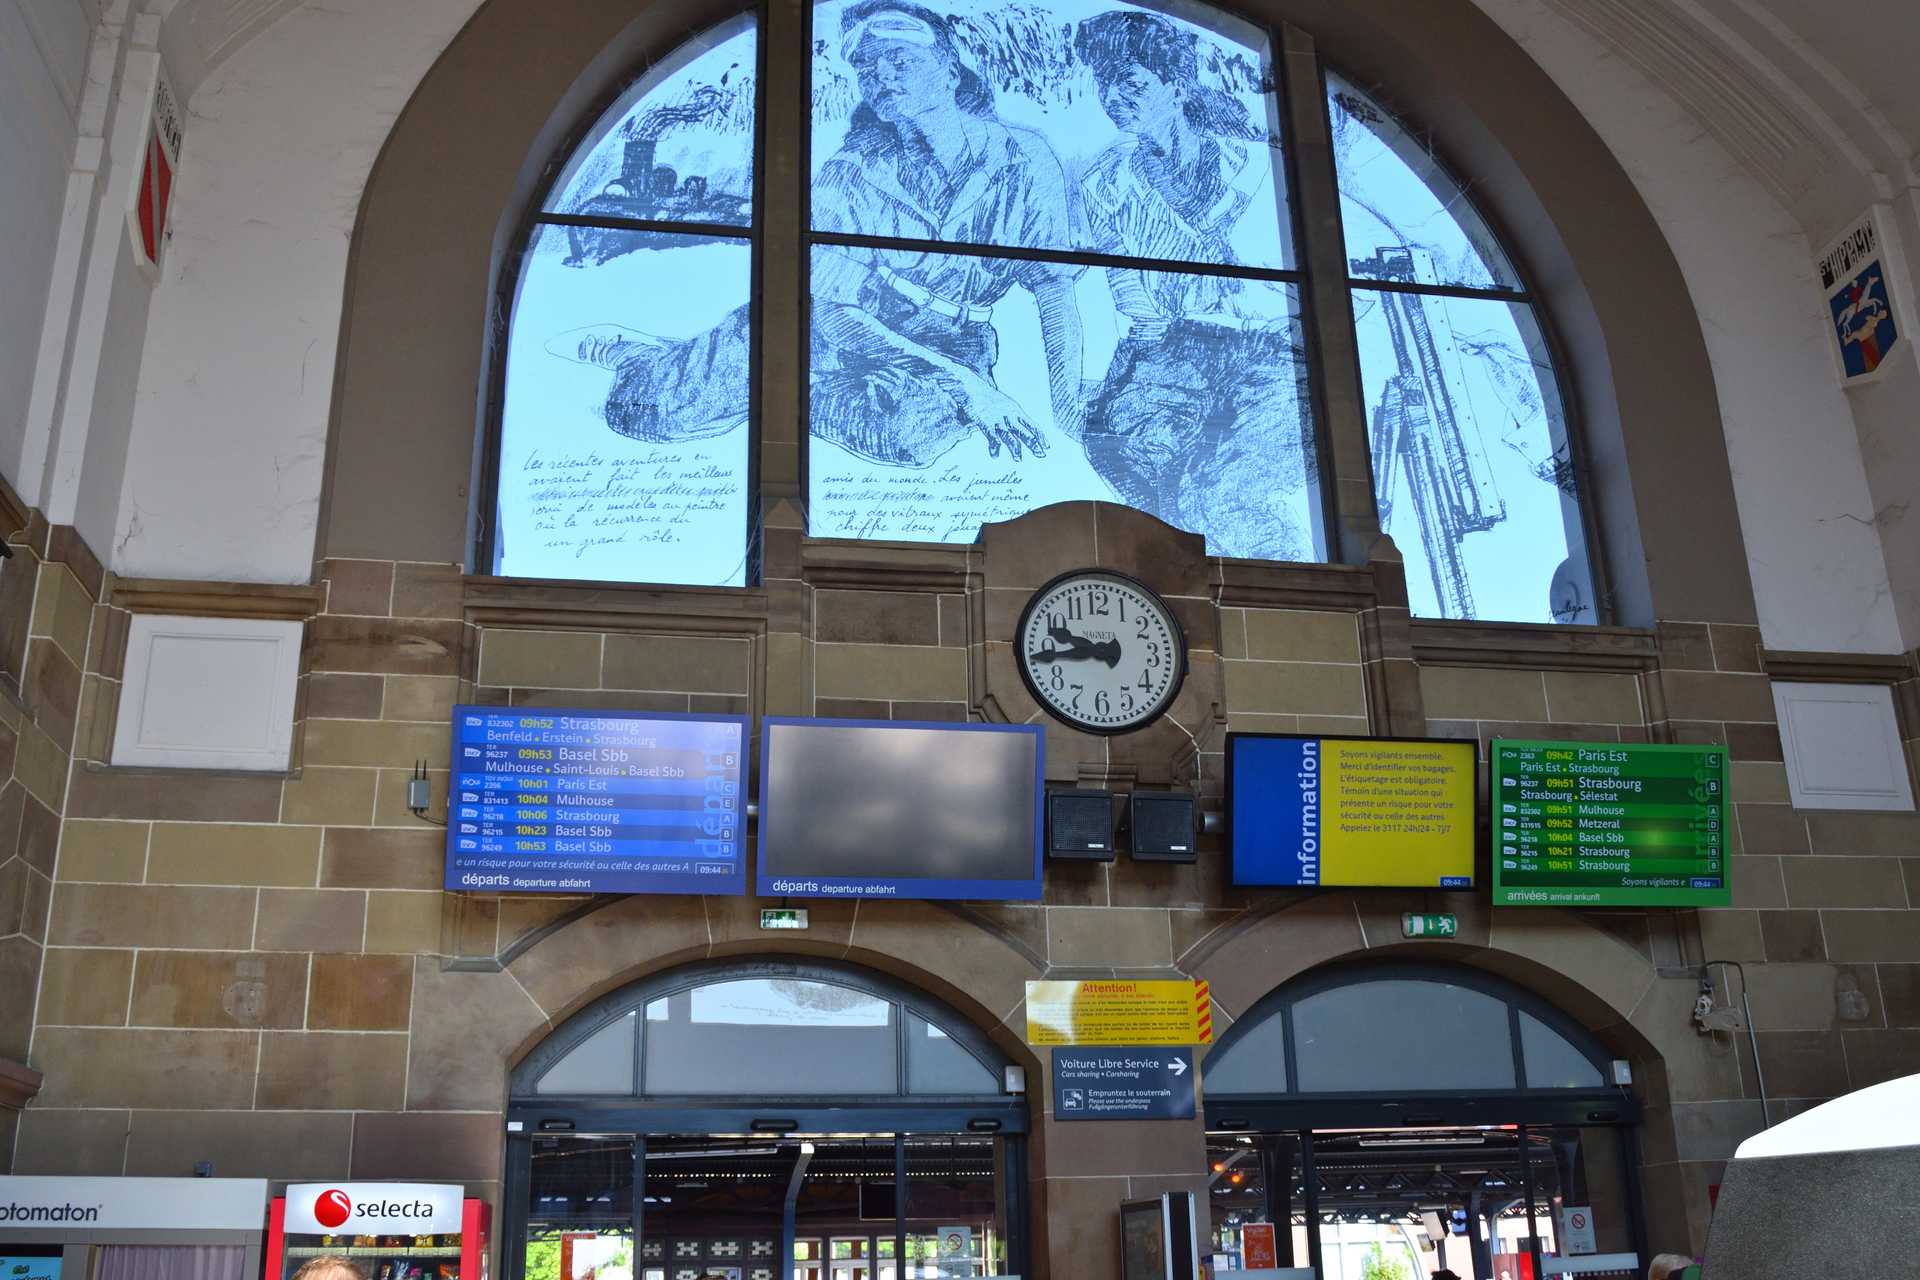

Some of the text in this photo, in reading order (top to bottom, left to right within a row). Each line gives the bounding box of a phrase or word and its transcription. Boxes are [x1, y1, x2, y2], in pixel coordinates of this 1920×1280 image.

[606, 467, 641, 490] fait
[823, 472, 854, 484] amis
[939, 465, 961, 482] Les
[963, 471, 1023, 493] jumelles
[576, 500, 594, 513] de
[564, 513, 577, 527] la
[669, 511, 692, 524] du
[835, 515, 936, 540] chiffre deux
[1067, 591, 1127, 623] 11 12 1
[1136, 616, 1150, 640] 2
[1147, 642, 1160, 668] 3
[1051, 665, 1154, 694] 8 4
[1070, 684, 1134, 716] 7 6 5
[519, 717, 640, 735] 09h52 Strasbourg
[487, 730, 656, 749] Benfeld Erstein Strasbourg
[518, 749, 553, 760] 09h53
[559, 747, 596, 761] Basel
[601, 748, 629, 762] Sbb
[726, 755, 734, 765] B
[1578, 749, 1606, 761] Paris
[1609, 750, 1627, 762] Est
[1709, 755, 1716, 764] C
[486, 761, 684, 778] Mulhouse Saint-Louis Basel Sbb
[1520, 762, 1619, 776] Paris Est Strasbourg
[518, 779, 607, 791] 10h01 Paris Est
[1546, 777, 1717, 792] 09h51 Strasbourg B
[517, 794, 615, 806] 10h04 Mulhouse
[1520, 789, 1618, 802] Strasbourg Sélestat
[516, 809, 620, 825] 10h06 Strasbourg
[1297, 741, 1317, 886] information
[1547, 805, 1573, 814] 09h51
[1579, 805, 1625, 815] Mulhouse
[515, 825, 547, 836] 10h23
[555, 824, 586, 837] Basel
[589, 825, 612, 838] Sbb
[1546, 818, 1573, 829] 09h52
[1579, 818, 1621, 829] Metzeral
[1547, 832, 1624, 843] 10h04 Basel Sbb
[515, 840, 612, 853] 10h53 Basel Sbb
[1547, 846, 1573, 856] 10h21
[1579, 846, 1631, 859] Strasbourg
[478, 857, 506, 869] risque
[508, 859, 531, 869] pour
[533, 860, 557, 869] votre
[559, 859, 594, 870] sécurité
[611, 861, 632, 870] celle
[634, 861, 650, 870] des
[652, 862, 680, 871] autres
[1548, 860, 1630, 872] 10h51 Strasbourg
[462, 873, 591, 888] départs departure abfahrt
[773, 879, 896, 895] départs departure abfahrt
[1622, 876, 1647, 888] Soyons
[1649, 877, 1679, 888] vigilants
[1507, 889, 1548, 901] arrivées
[1550, 893, 1573, 901] arrival
[1082, 983, 1137, 993] Attention!
[1061, 1058, 1159, 1069] Voiture Libre Service
[1077, 1071, 1100, 1079] sharing
[1106, 1071, 1140, 1079] Carsharing
[1089, 1089, 1126, 1098] Empruntez
[1136, 1089, 1171, 1097] souterrain
[356, 1200, 433, 1218] selecta
